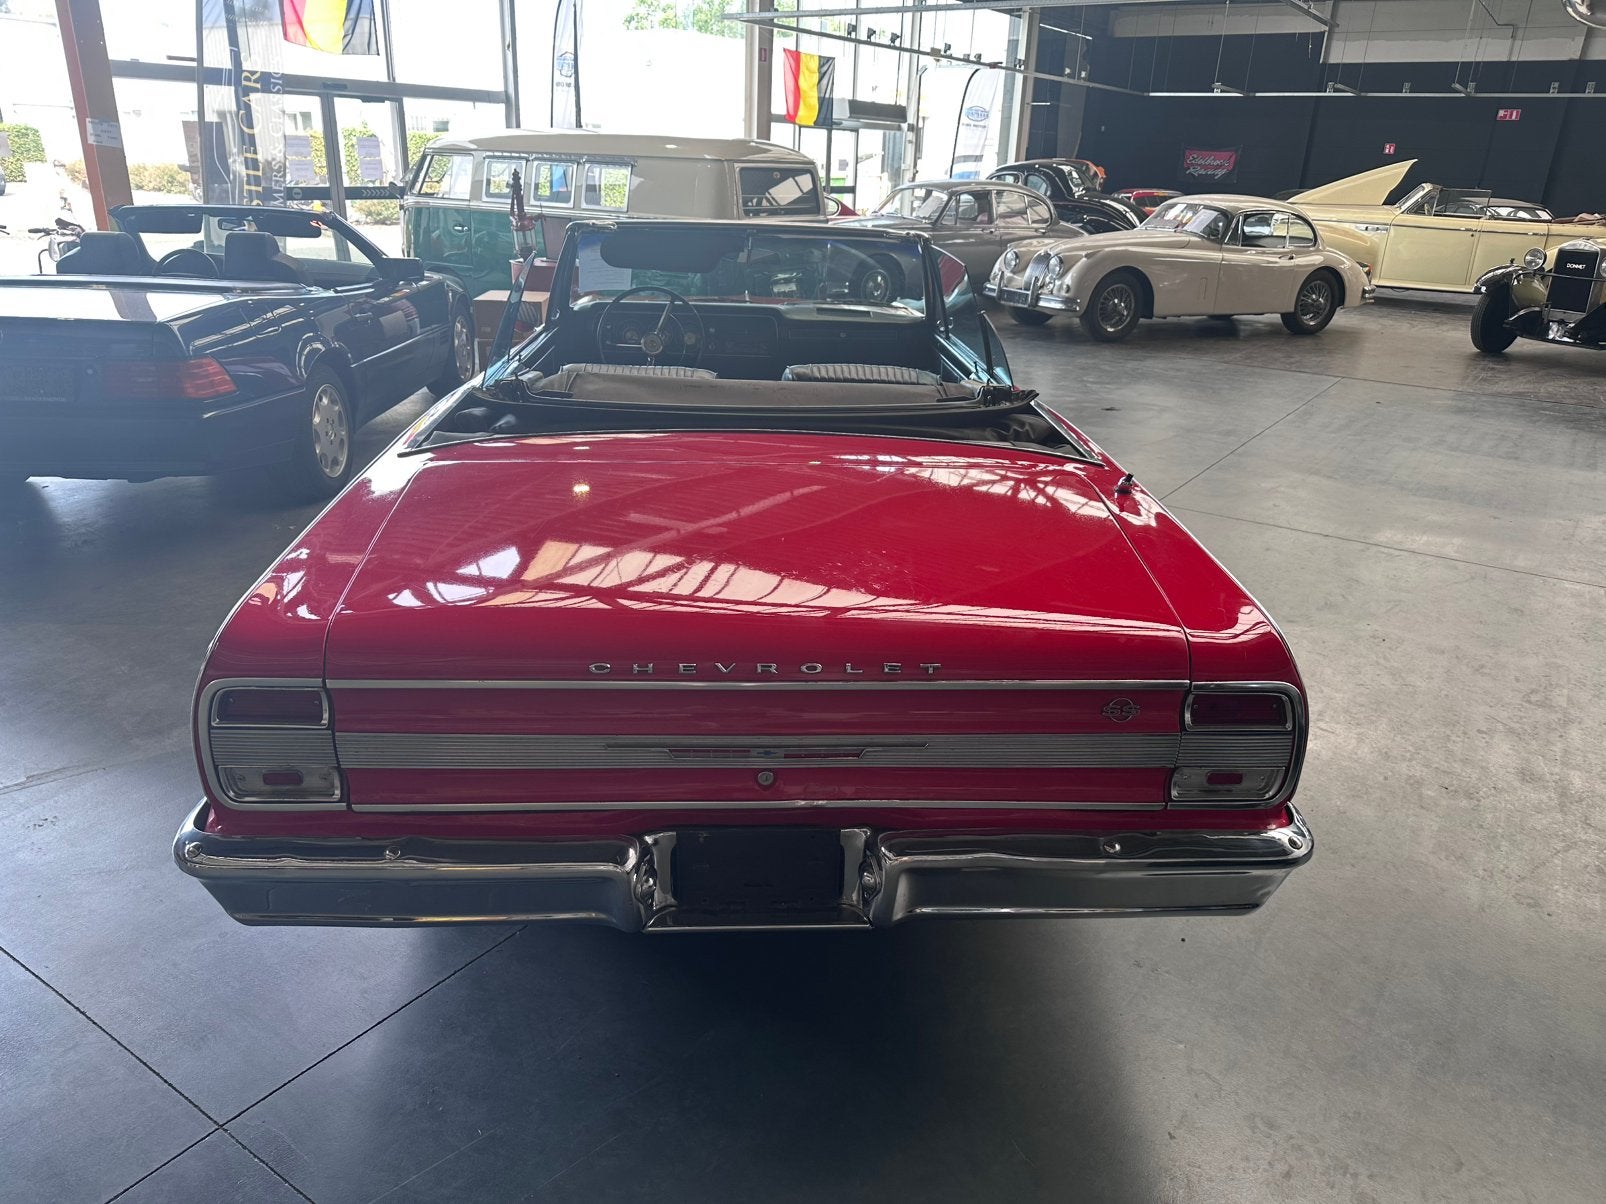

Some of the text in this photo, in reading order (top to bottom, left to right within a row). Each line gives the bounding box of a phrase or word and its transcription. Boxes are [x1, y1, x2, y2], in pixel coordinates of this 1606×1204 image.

[270, 143, 284, 156] &
[1186, 166, 1229, 180] Racing
[1566, 262, 1587, 270] DONNET
[588, 662, 942, 675] CHEVROLET
